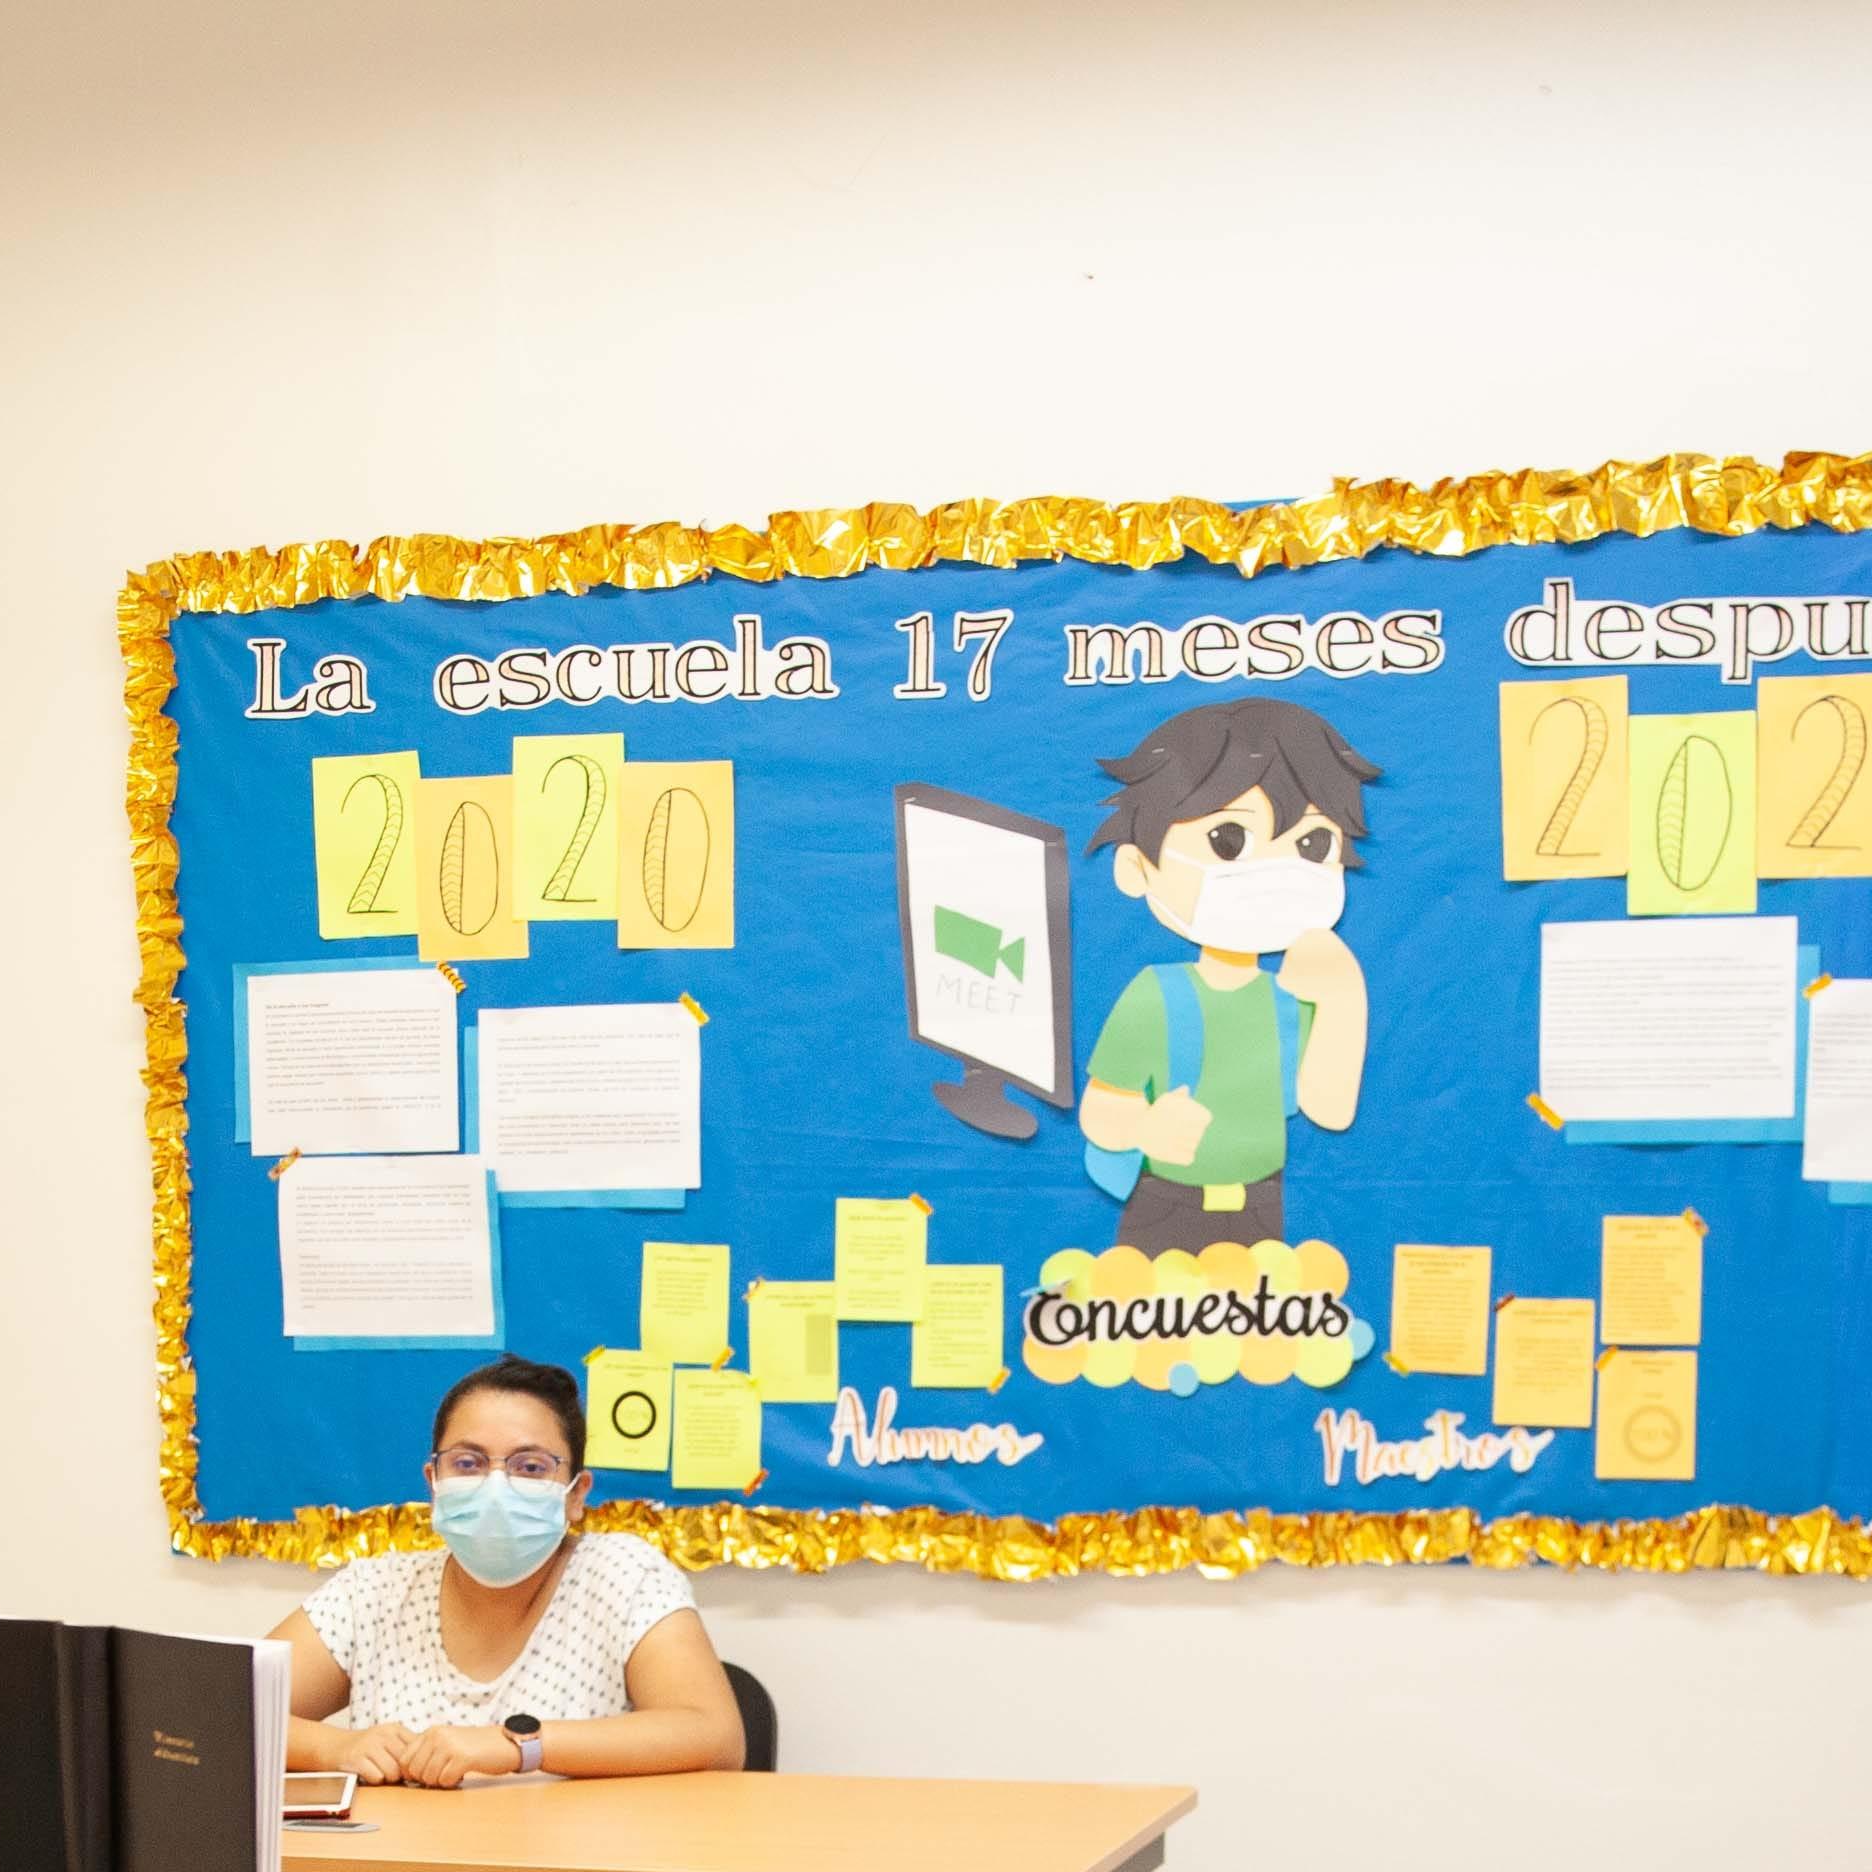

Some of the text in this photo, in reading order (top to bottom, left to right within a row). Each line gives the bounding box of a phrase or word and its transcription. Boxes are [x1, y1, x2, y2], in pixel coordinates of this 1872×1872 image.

[249, 640, 371, 714] La
[437, 618, 834, 708] escuela
[896, 612, 1012, 698] 17
[1067, 612, 1442, 683] meses
[340, 754, 712, 935] 2020
[936, 974, 1025, 1014] MEET
[1028, 1274, 1350, 1345] Encuestas
[828, 1387, 1044, 1467] Alumnos
[1314, 1408, 1555, 1486] Maestros
